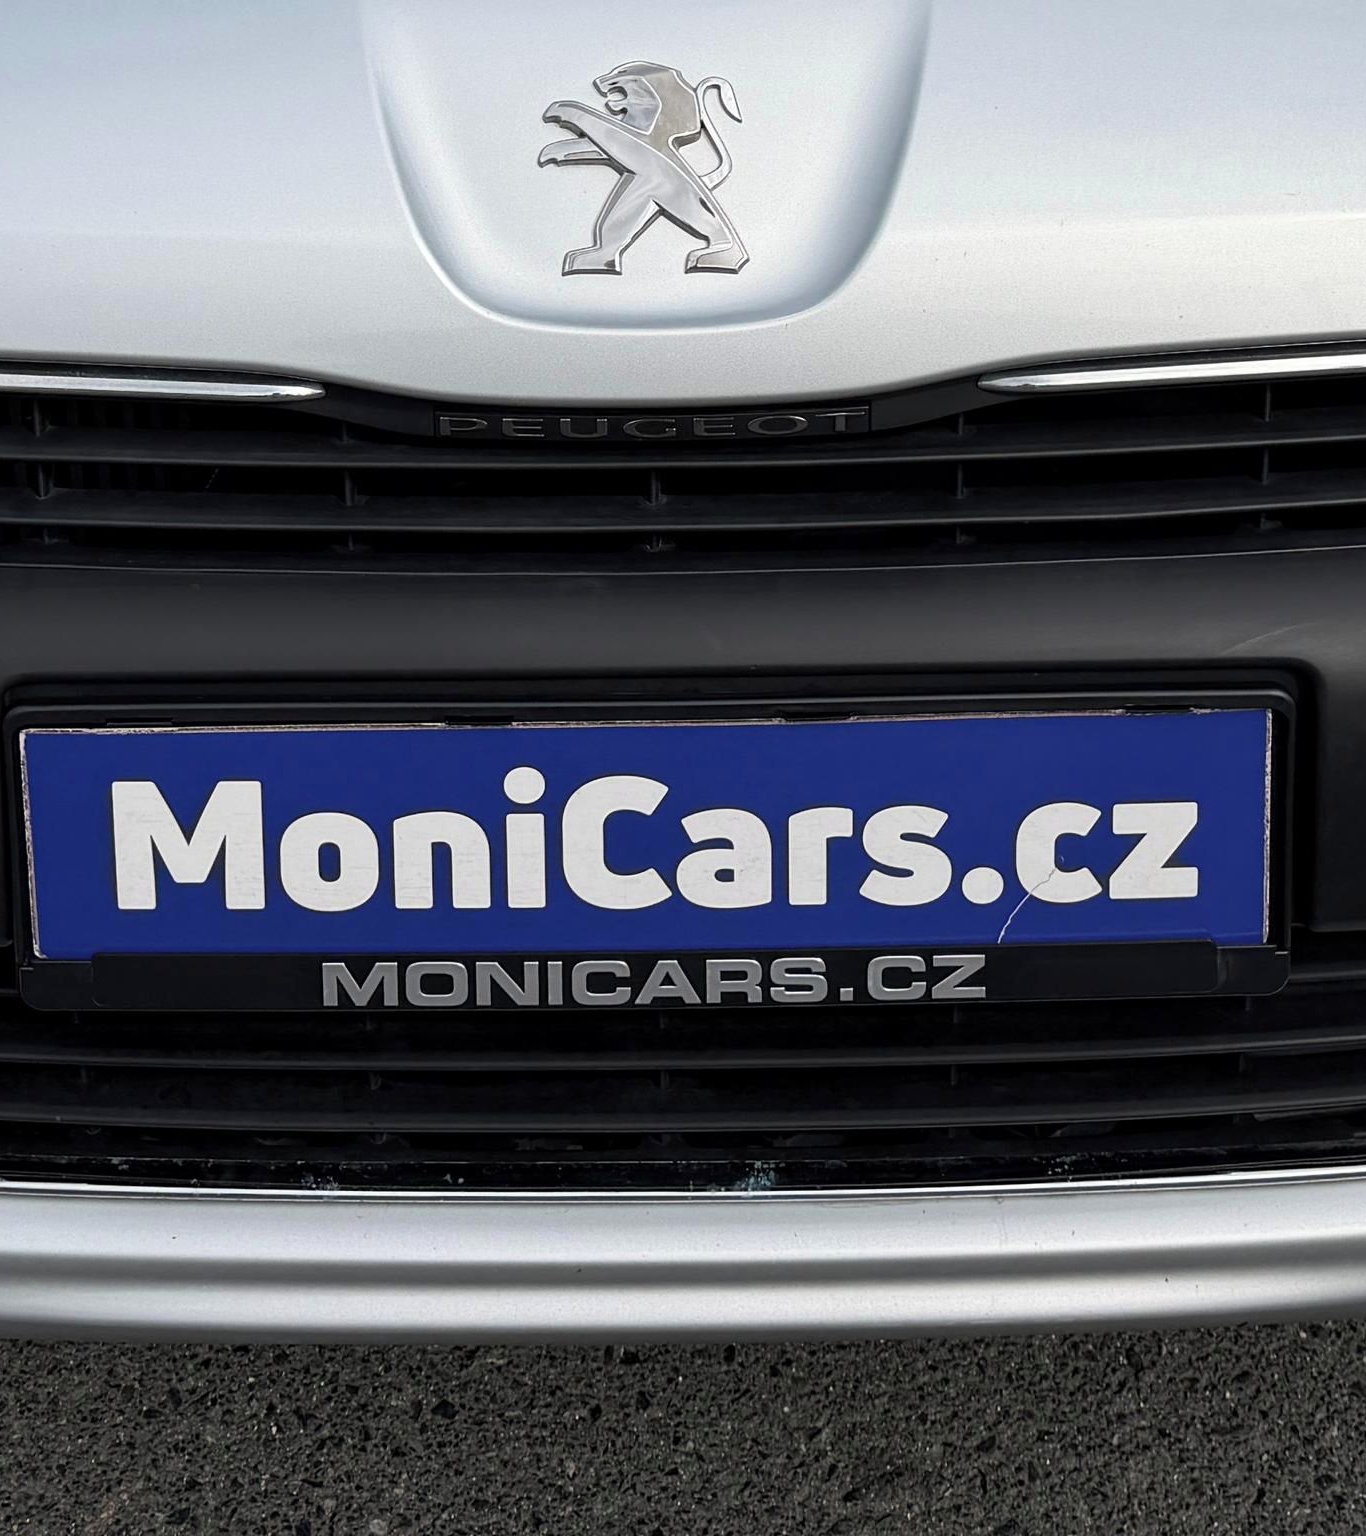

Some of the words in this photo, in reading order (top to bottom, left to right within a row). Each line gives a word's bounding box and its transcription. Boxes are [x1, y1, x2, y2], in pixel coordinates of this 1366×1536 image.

[439, 411, 866, 439] PEUGEOT
[112, 767, 1199, 912] MoniCars.cz
[322, 954, 987, 1007] MONICARS.CZ
